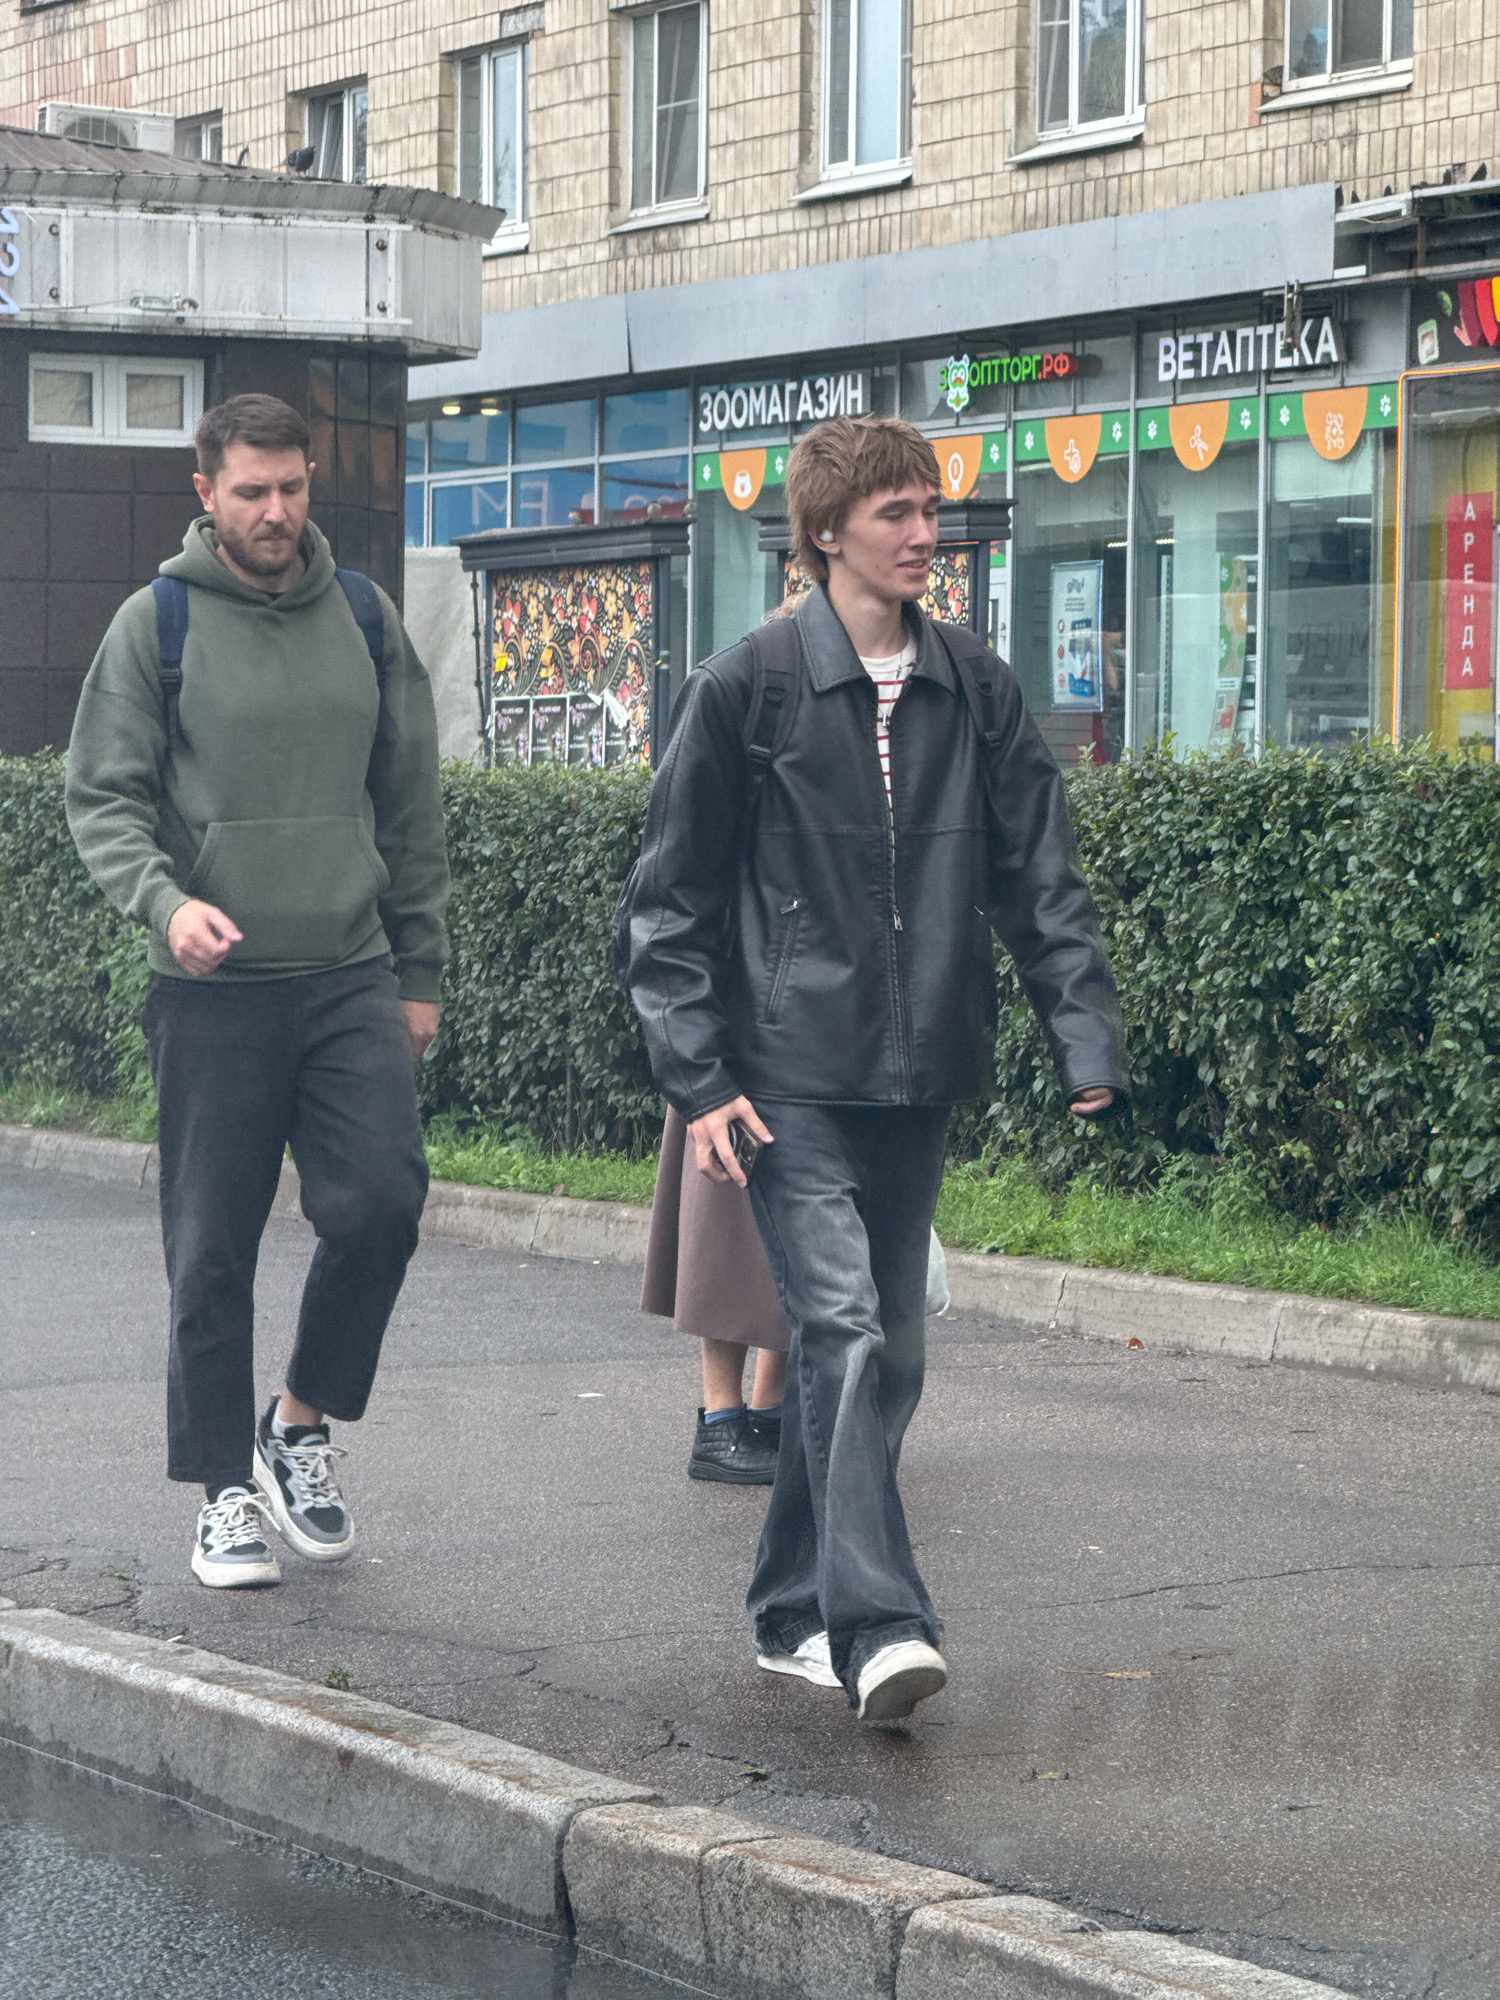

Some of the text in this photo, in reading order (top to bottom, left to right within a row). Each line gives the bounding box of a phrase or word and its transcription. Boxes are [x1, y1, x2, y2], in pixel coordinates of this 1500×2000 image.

[1158, 316, 1339, 382] ВЕТАПТЕКА
[699, 373, 863, 432] ЗООМАГАЗИН
[1461, 500, 1476, 677] АРЕНДА
